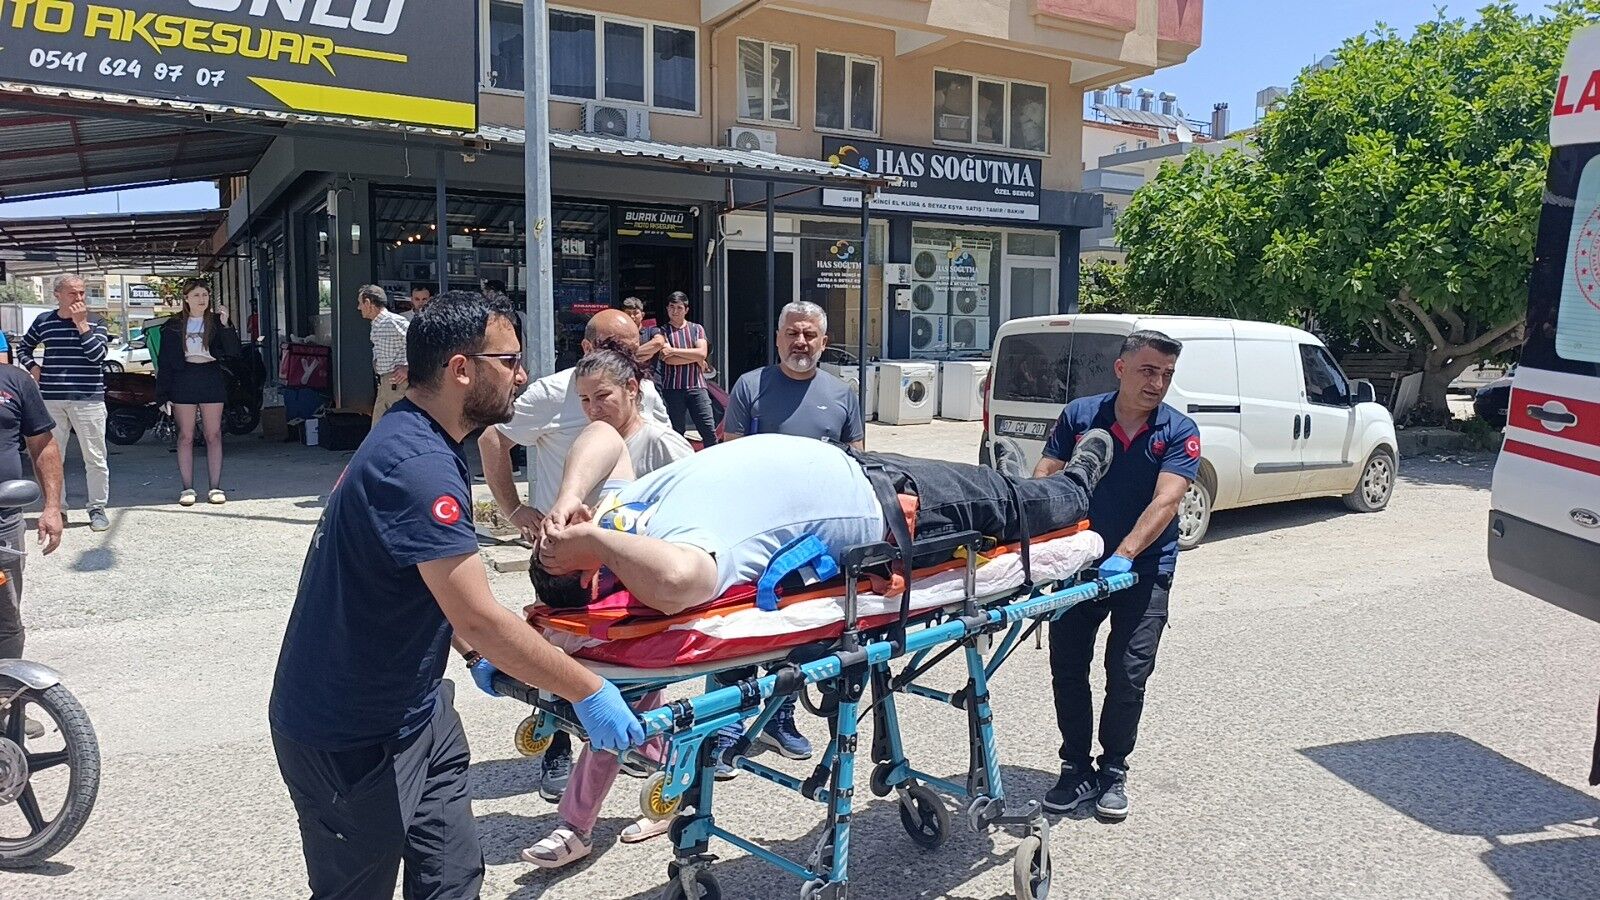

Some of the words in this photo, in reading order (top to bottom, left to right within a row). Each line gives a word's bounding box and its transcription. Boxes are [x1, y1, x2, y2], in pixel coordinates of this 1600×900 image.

[84, 4, 336, 77] AKSESUAR
[29, 48, 88, 73] 0541
[99, 56, 141, 79] 624
[153, 62, 184, 83] 97
[196, 67, 226, 88] 07
[876, 148, 925, 178] HAS
[930, 153, 1035, 187] SOĞUTMA
[994, 187, 1011, 196] ÖZEL
[1012, 189, 1035, 198] SERVİS
[901, 200, 920, 208] KLİMA
[625, 211, 658, 222] BURAK
[660, 212, 684, 224] ÜNLÜ
[816, 260, 832, 268] HAS
[1003, 420, 1012, 431] 07
[1015, 421, 1029, 432] CGV
[1031, 423, 1046, 434] 207
[1573, 511, 1594, 525] Ford
